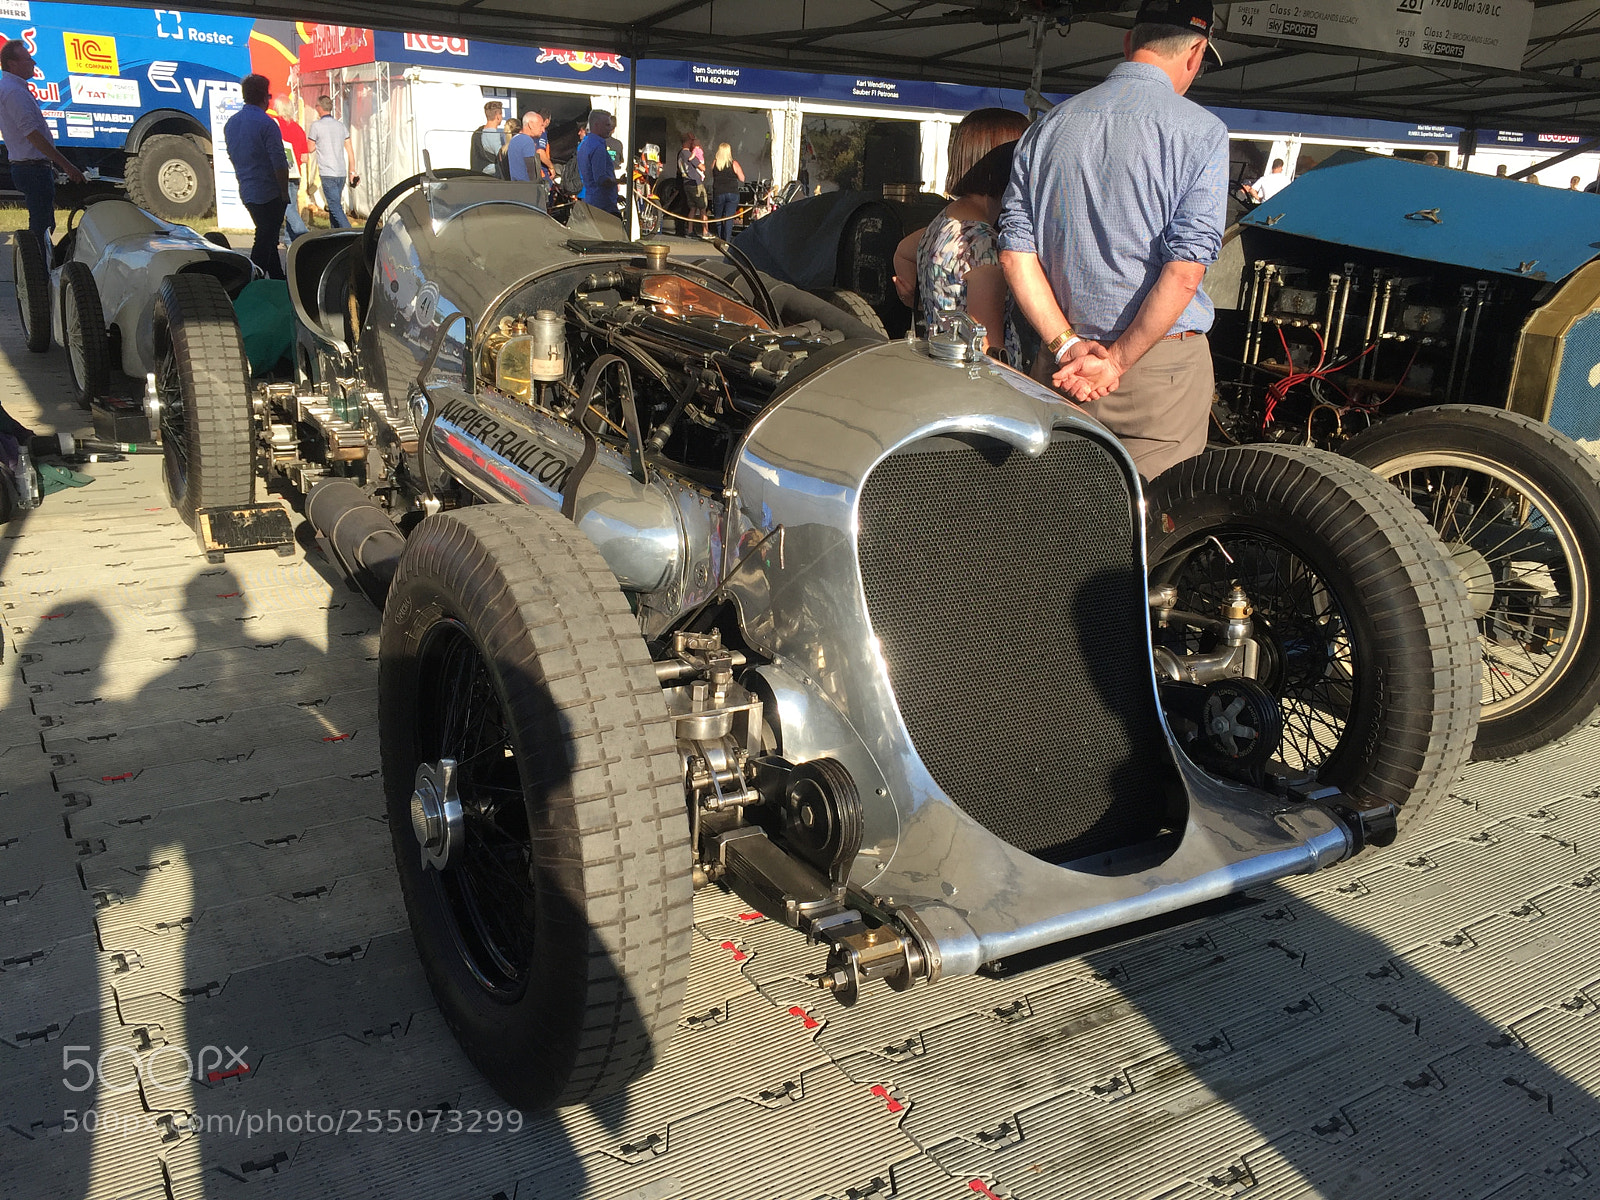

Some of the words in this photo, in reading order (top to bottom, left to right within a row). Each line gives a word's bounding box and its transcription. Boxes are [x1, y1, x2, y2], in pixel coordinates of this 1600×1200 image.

[1269, 4, 1291, 16] Class
[1476, 3, 1490, 15] 3/8
[1491, 5, 1501, 17] LC
[1241, 14, 1253, 27] 94
[1267, 19, 1282, 32] sky
[1283, 23, 1317, 37] SPORTS
[1424, 26, 1443, 38] Class
[188, 28, 233, 45] Rostec
[1398, 37, 1409, 48] 93
[1435, 44, 1464, 56] SPORTS
[692, 66, 706, 74] Sam
[706, 67, 740, 76] Sunderland
[695, 75, 709, 83] KTM
[722, 77, 737, 86] Rally
[867, 81, 896, 90] Wendlinger
[87, 91, 134, 99] TATNEFT
[852, 88, 871, 96] Sauber
[877, 90, 899, 98] Petronas
[93, 112, 134, 123] WABCO
